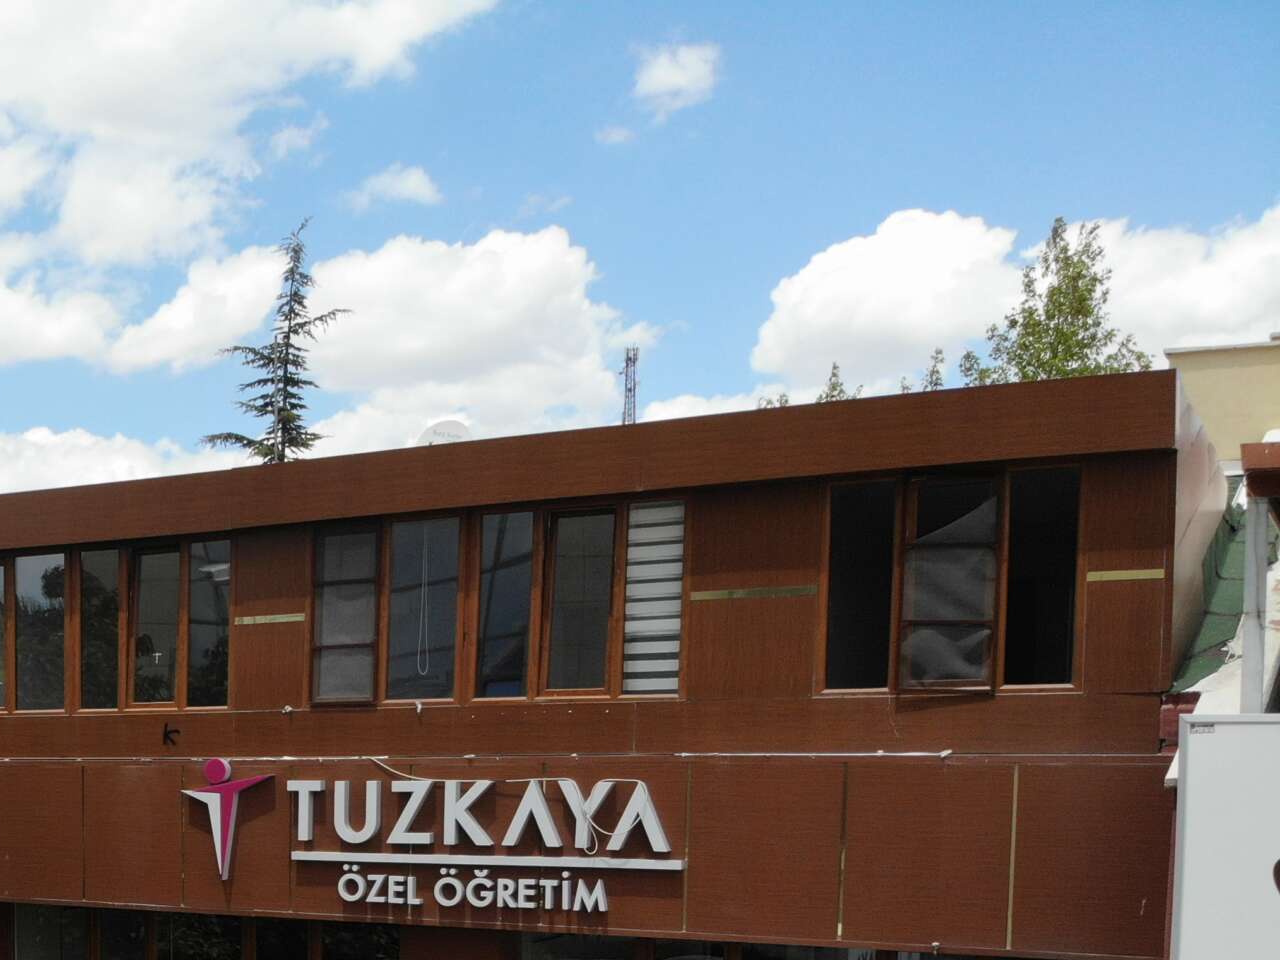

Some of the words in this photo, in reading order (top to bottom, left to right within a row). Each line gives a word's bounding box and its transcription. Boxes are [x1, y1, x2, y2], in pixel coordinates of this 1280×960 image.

[286, 778, 672, 854] TUZKAYA
[336, 863, 424, 906] ÖZEL
[433, 867, 609, 913] ÖĞRETİM
